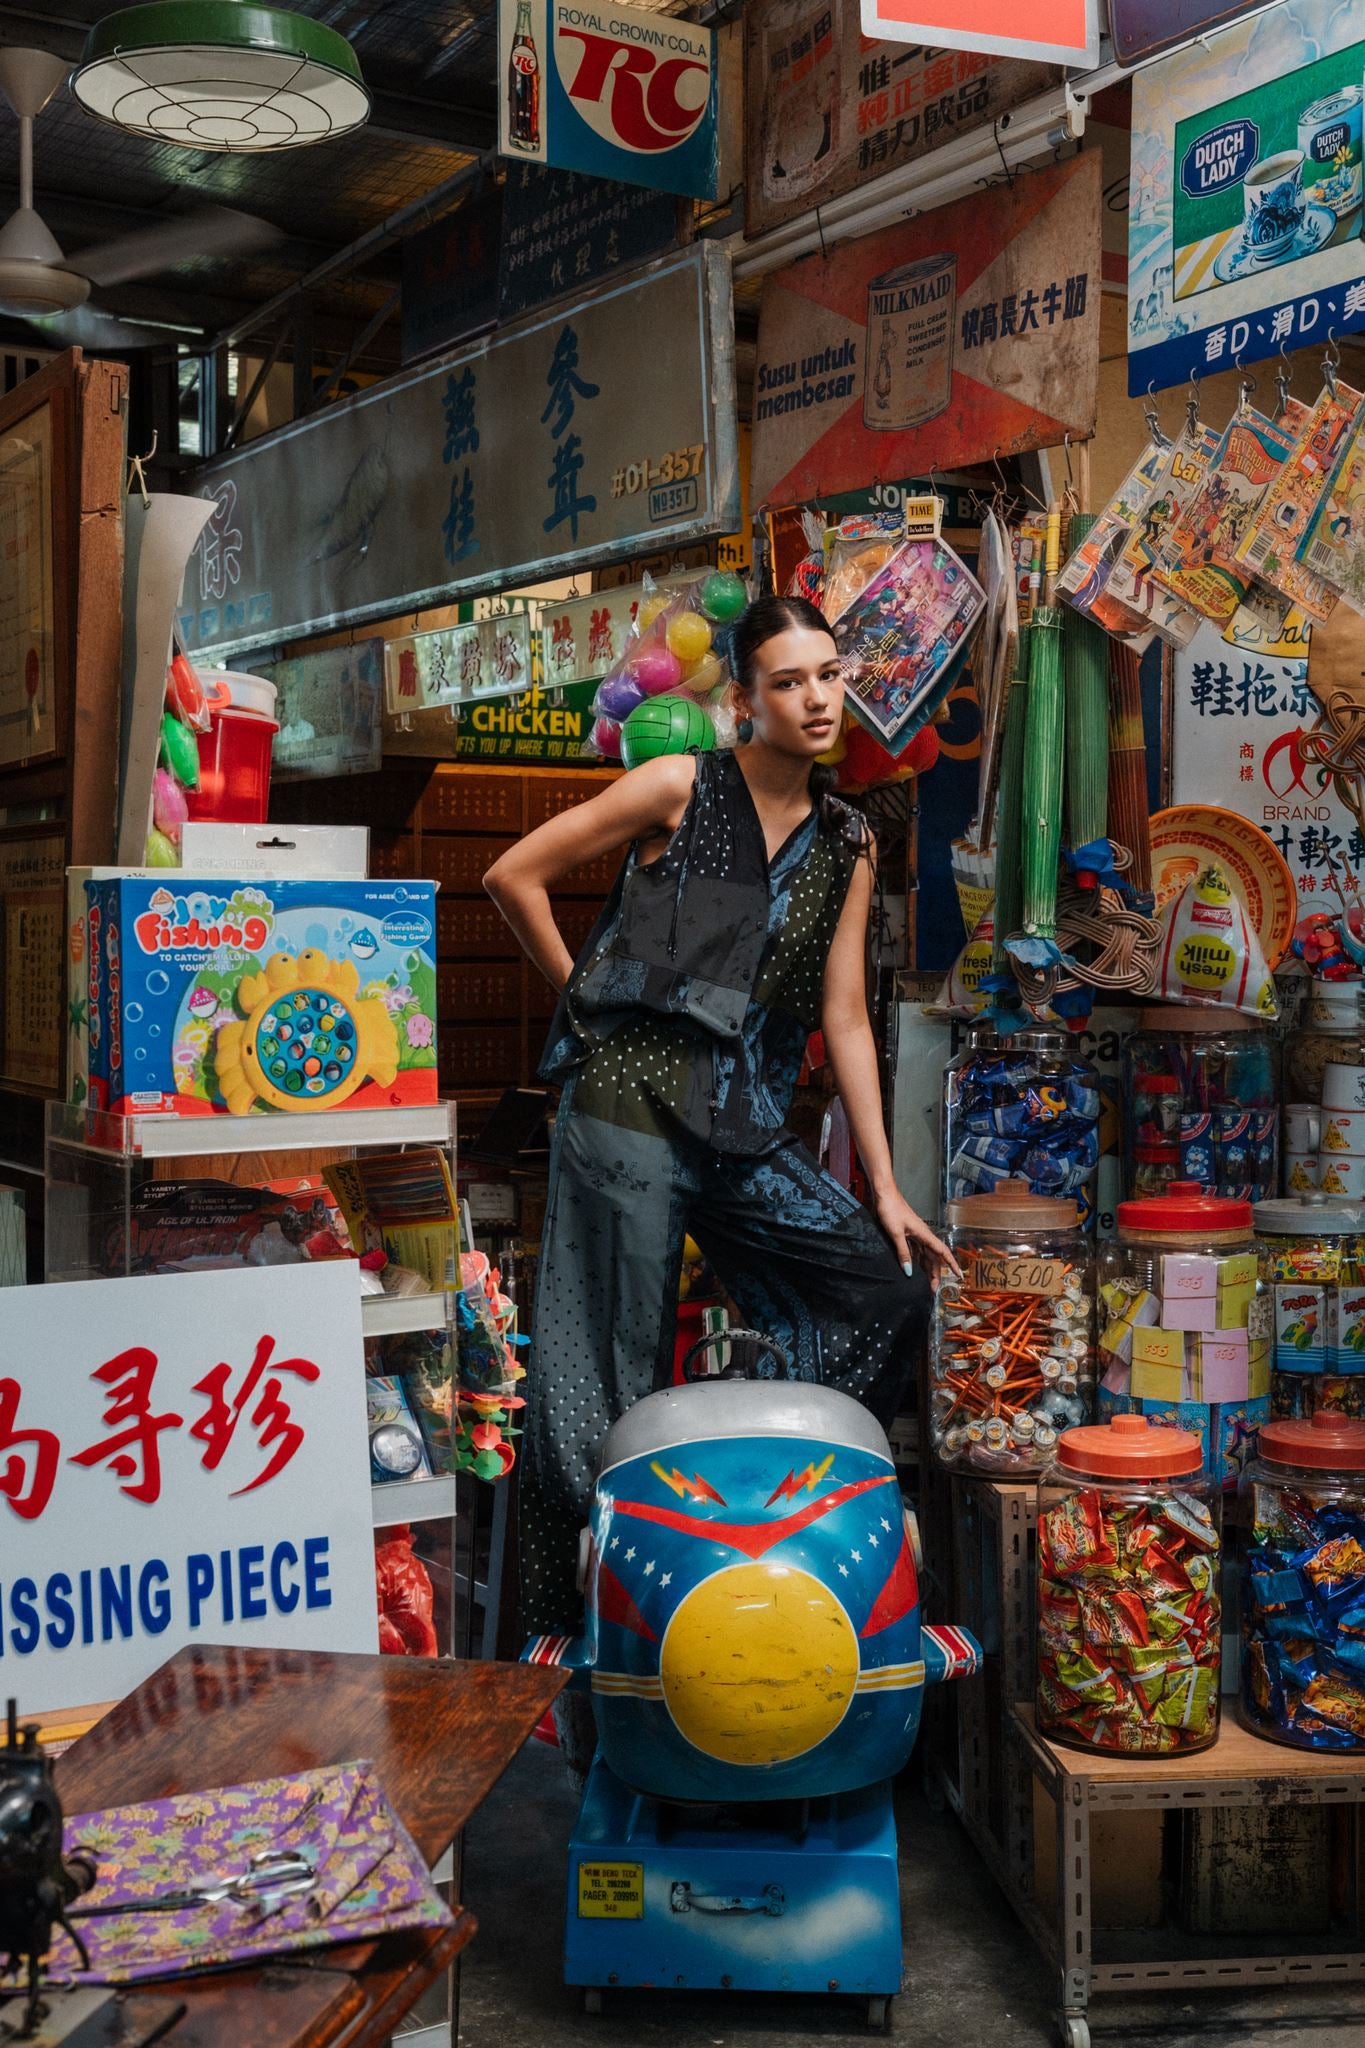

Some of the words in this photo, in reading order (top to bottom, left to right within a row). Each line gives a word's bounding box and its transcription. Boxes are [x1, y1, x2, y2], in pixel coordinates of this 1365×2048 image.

[558, 6, 606, 32] ROYAL
[609, 20, 664, 46] CROWN
[667, 36, 707, 57] COLA
[513, 54, 536, 73] RC
[558, 26, 709, 150] RC
[1317, 128, 1344, 148] DUTCH
[1195, 130, 1245, 169] DUTCH
[1320, 143, 1340, 159] LADY
[1201, 155, 1239, 188] LADY
[873, 273, 951, 315] MILKMAID
[908, 319, 924, 332] FULL
[926, 309, 947, 325] CREAM
[758, 362, 796, 393] Susu
[800, 338, 856, 378] untuk
[905, 358, 924, 369] MILK
[756, 373, 856, 421] membesar
[1229, 437, 1276, 475] RIVERDALE
[610, 443, 704, 500] #01-357
[910, 505, 931, 516] TIME
[480, 737, 497, 754] YOU
[499, 738, 512, 753] UP
[548, 741, 566, 757] YOU
[1263, 805, 1331, 821] BRAND
[1214, 816, 1289, 940] CIGARETTES
[137, 914, 267, 951] Fishing
[381, 934, 407, 942] Fishing
[408, 933, 431, 941] Game
[384, 924, 425, 933] Interesting
[160, 953, 172, 962] TO
[1184, 943, 1230, 957] milk
[180, 964, 204, 972] YOUR
[1180, 960, 1228, 975] fresh
[157, 1217, 177, 1225] AGE
[180, 1216, 195, 1225] OF
[196, 1215, 238, 1224] ULTRON
[1177, 1276, 1204, 1290] 555
[1232, 1269, 1250, 1285] 555
[1281, 1294, 1318, 1312] TORA
[1144, 1342, 1169, 1358] 555
[1214, 1346, 1238, 1360] 555
[0, 1558, 172, 1658] SSING
[187, 1536, 332, 1628] PIECE
